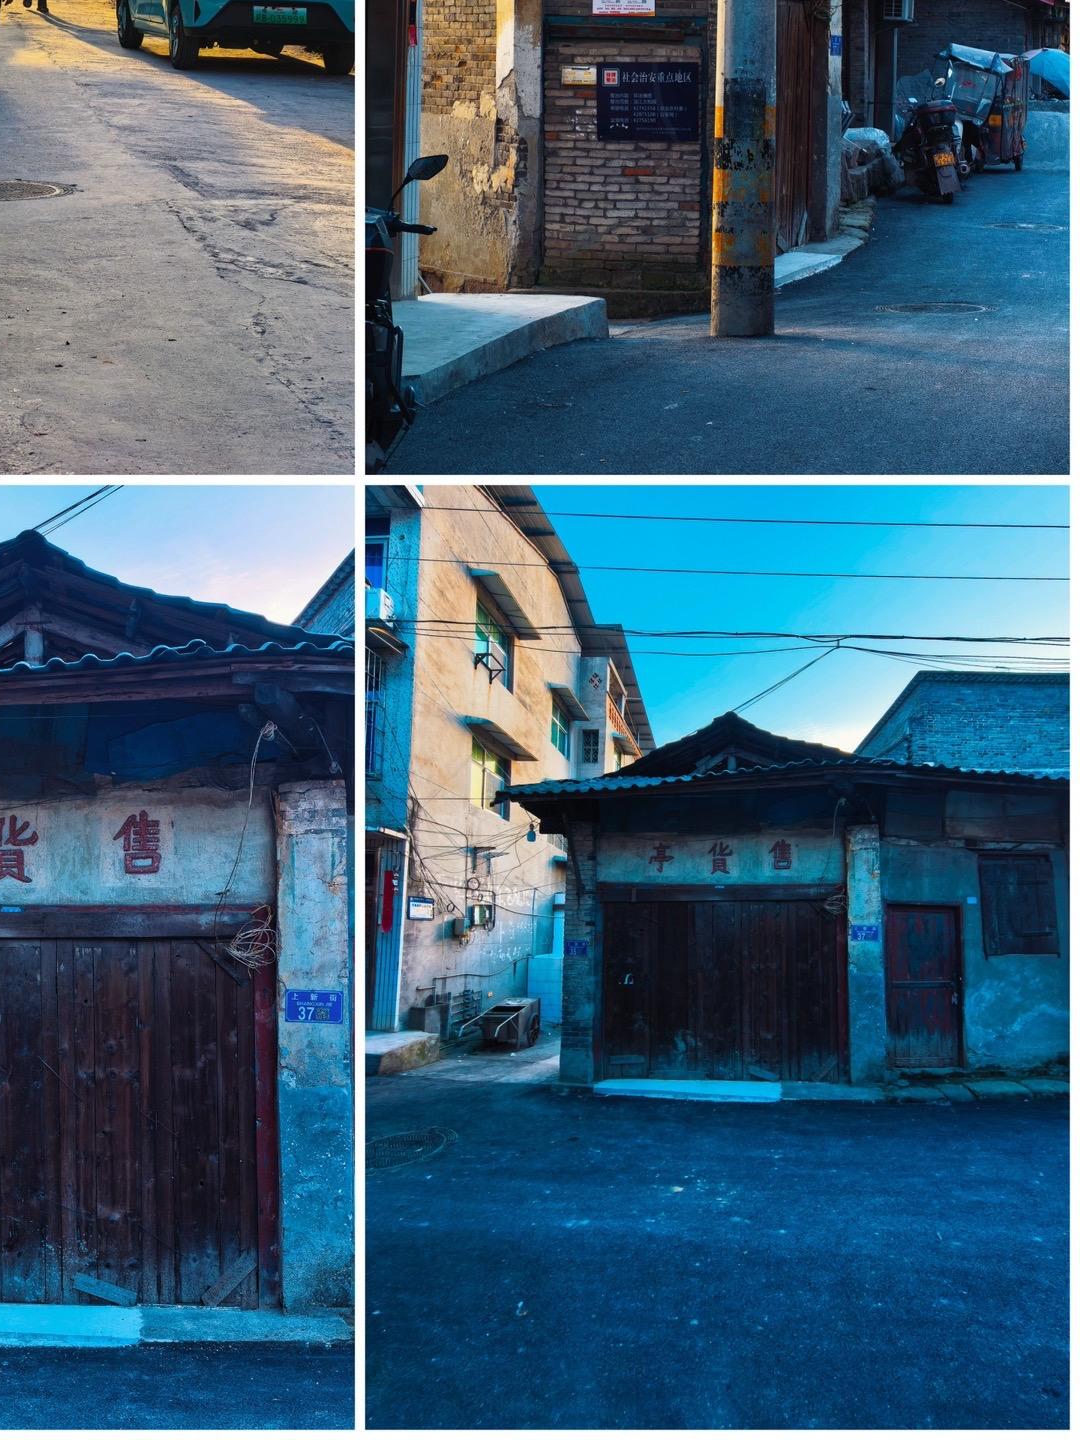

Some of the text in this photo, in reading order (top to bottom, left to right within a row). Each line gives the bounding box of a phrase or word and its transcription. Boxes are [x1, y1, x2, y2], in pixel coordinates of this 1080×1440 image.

[622, 71, 693, 84] 社会治安重点地区
[298, 1006, 315, 1020] 37
